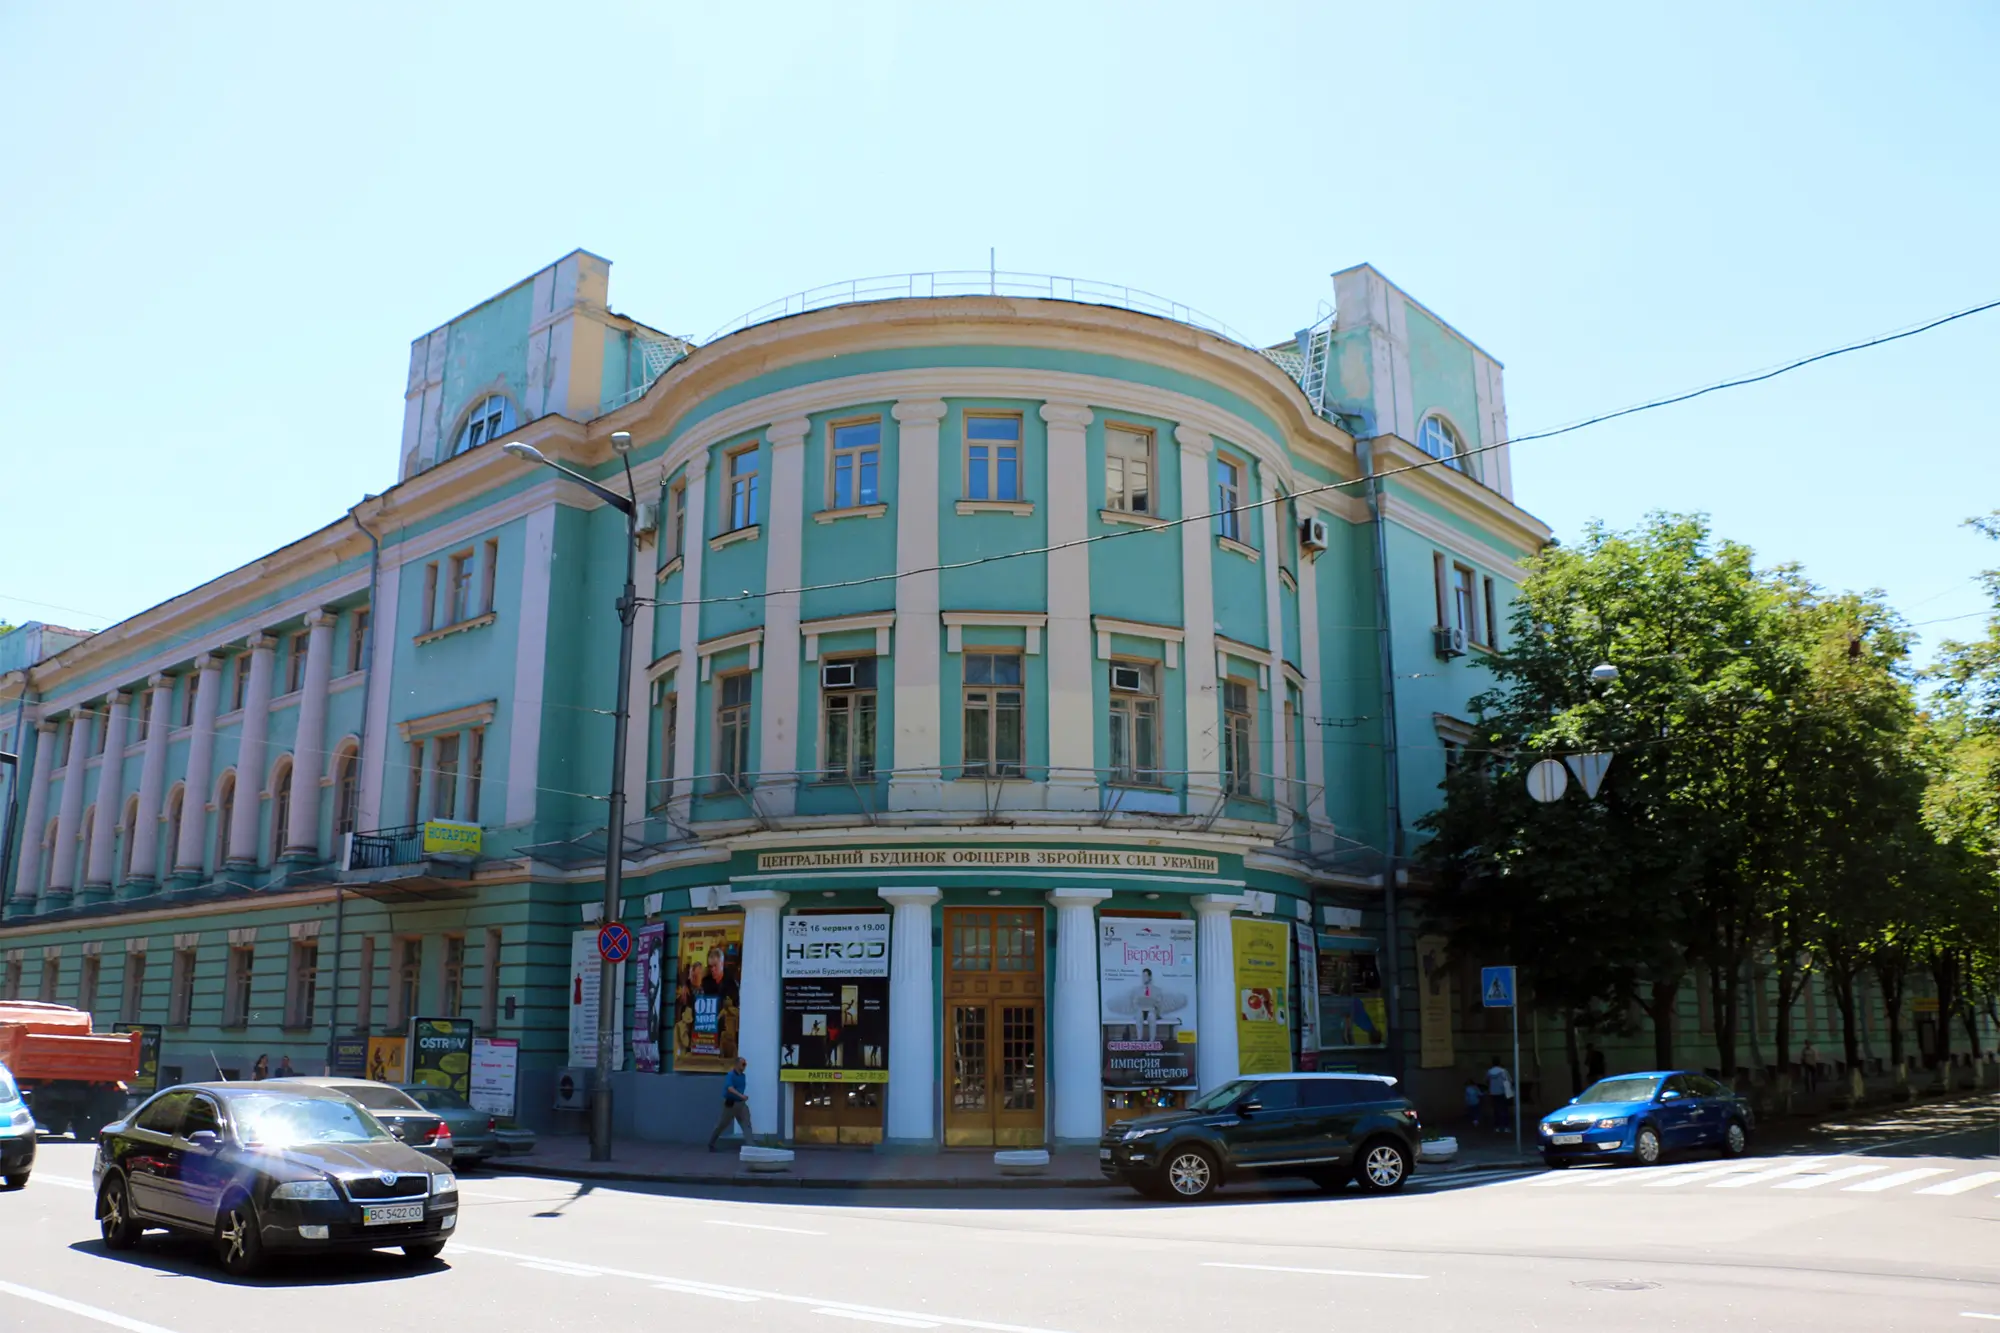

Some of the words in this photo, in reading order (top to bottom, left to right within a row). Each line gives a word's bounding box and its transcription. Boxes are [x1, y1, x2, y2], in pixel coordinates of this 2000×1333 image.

[762, 850, 863, 868] ЦЕНТРАЛЬНИЙ
[870, 851, 946, 865] БУДИНОК
[953, 851, 1030, 866] ОФІЦЕРІВ
[1037, 850, 1120, 866] ЗБРОЙНИХ
[1126, 854, 1156, 867] СИЛ
[1162, 856, 1215, 871] УКРАЇНИ
[1104, 926, 1115, 937] 15
[786, 942, 885, 960] HEROD
[822, 967, 852, 976] Будинок
[853, 967, 884, 975] офіцерів
[1110, 1058, 1160, 1072] империя
[1144, 1068, 1189, 1078] ангелов
[370, 1209, 384, 1220] BC
[386, 1207, 407, 1219] 5422
[409, 1206, 422, 1217] CO
